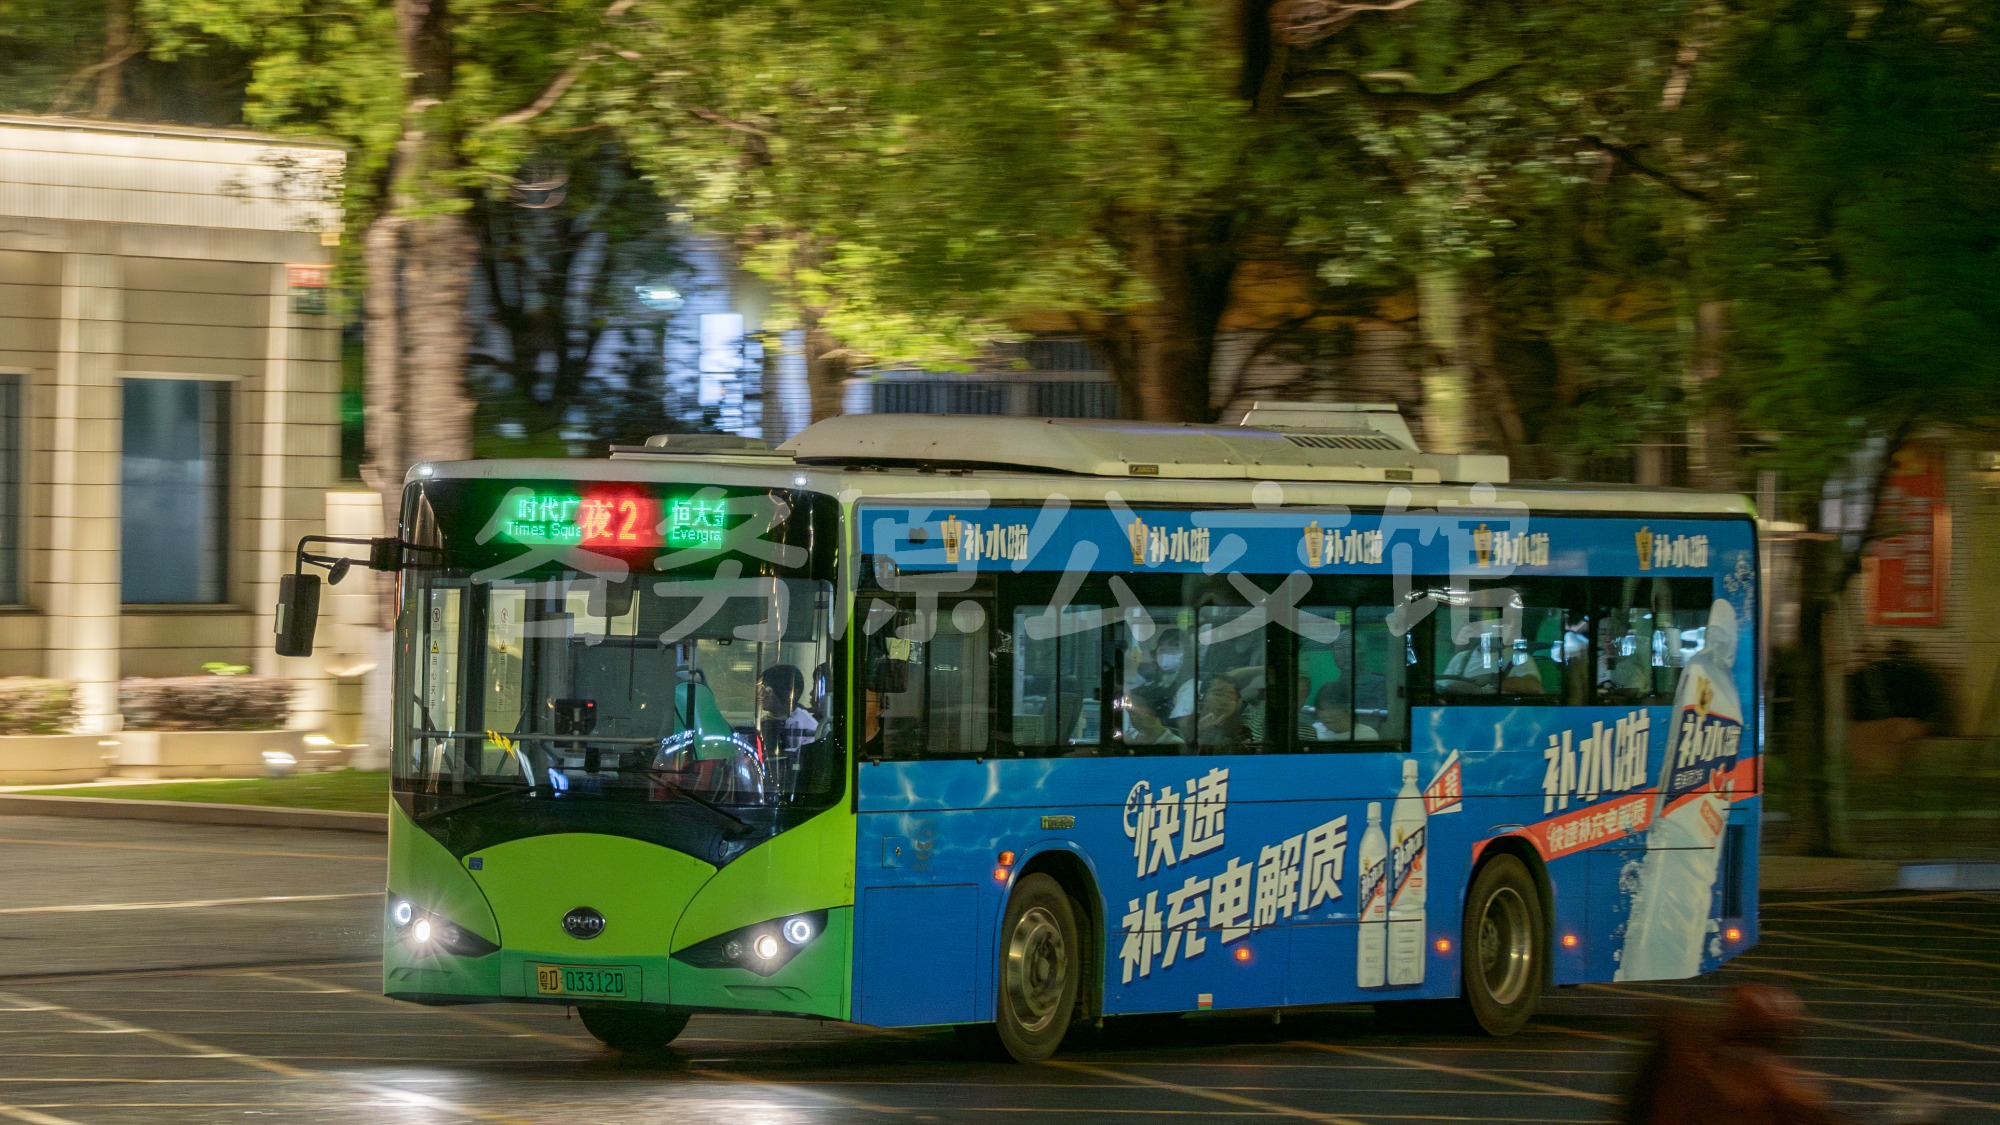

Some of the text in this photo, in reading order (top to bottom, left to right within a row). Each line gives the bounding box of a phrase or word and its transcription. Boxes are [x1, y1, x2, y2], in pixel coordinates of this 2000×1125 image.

[506, 522, 545, 536] Times
[964, 523, 1028, 561] 补水啦
[1150, 526, 1210, 562] 补水啦
[1324, 529, 1383, 564] 补水啦
[1543, 708, 1649, 814] 补水啦
[1124, 767, 1229, 879] 快速
[1118, 814, 1348, 985] 补充电解质
